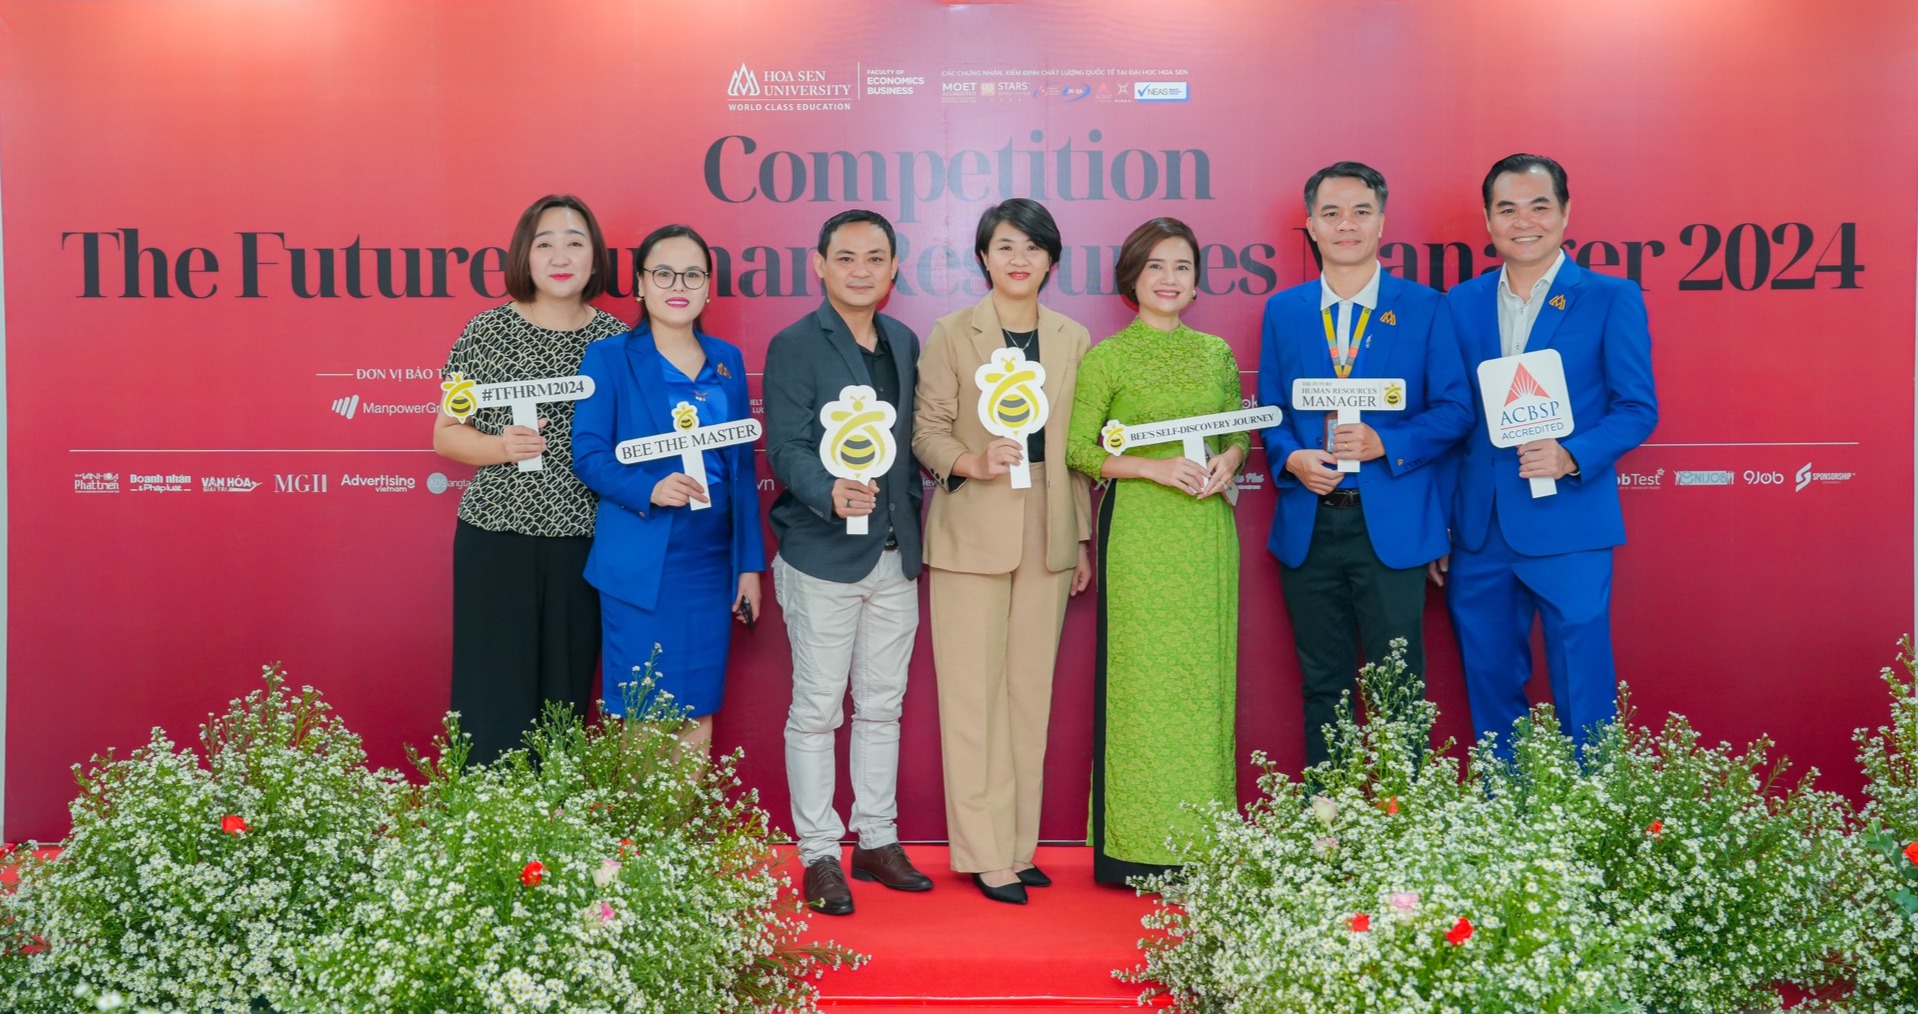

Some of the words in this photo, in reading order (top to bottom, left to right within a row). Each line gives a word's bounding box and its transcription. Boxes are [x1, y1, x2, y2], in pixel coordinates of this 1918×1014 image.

[764, 70, 794, 82] HOA
[798, 70, 826, 82] SEN
[867, 76, 925, 85] ECONOMICS
[764, 85, 851, 96] UNIVERSITY
[867, 86, 914, 95] BUSINESS
[942, 82, 977, 92] MOET
[997, 81, 1028, 91] STARS
[1147, 88, 1168, 96] NEAS
[797, 103, 851, 111] EDUCATION
[703, 129, 1215, 223] Competition
[61, 227, 219, 299] The
[234, 231, 507, 299] Future
[1679, 222, 1865, 292] 2024
[356, 368, 386, 380] ĐƠN
[389, 368, 402, 382] VỊ
[405, 366, 433, 380] BẢO
[481, 380, 585, 402] #TFHRM2024
[1302, 395, 1377, 407] MANAGER
[363, 402, 440, 416] ManpowerGr
[1500, 400, 1560, 426] ACBSP
[1156, 419, 1231, 437] SELF-DISCOVERY
[1232, 412, 1275, 427] JOURNEY
[1501, 422, 1564, 440] ACCREDITED
[621, 442, 653, 460] BEE
[654, 436, 689, 454] THE
[691, 423, 758, 447] MASTER
[130, 474, 163, 484] Doanh
[340, 474, 416, 489] Advertising
